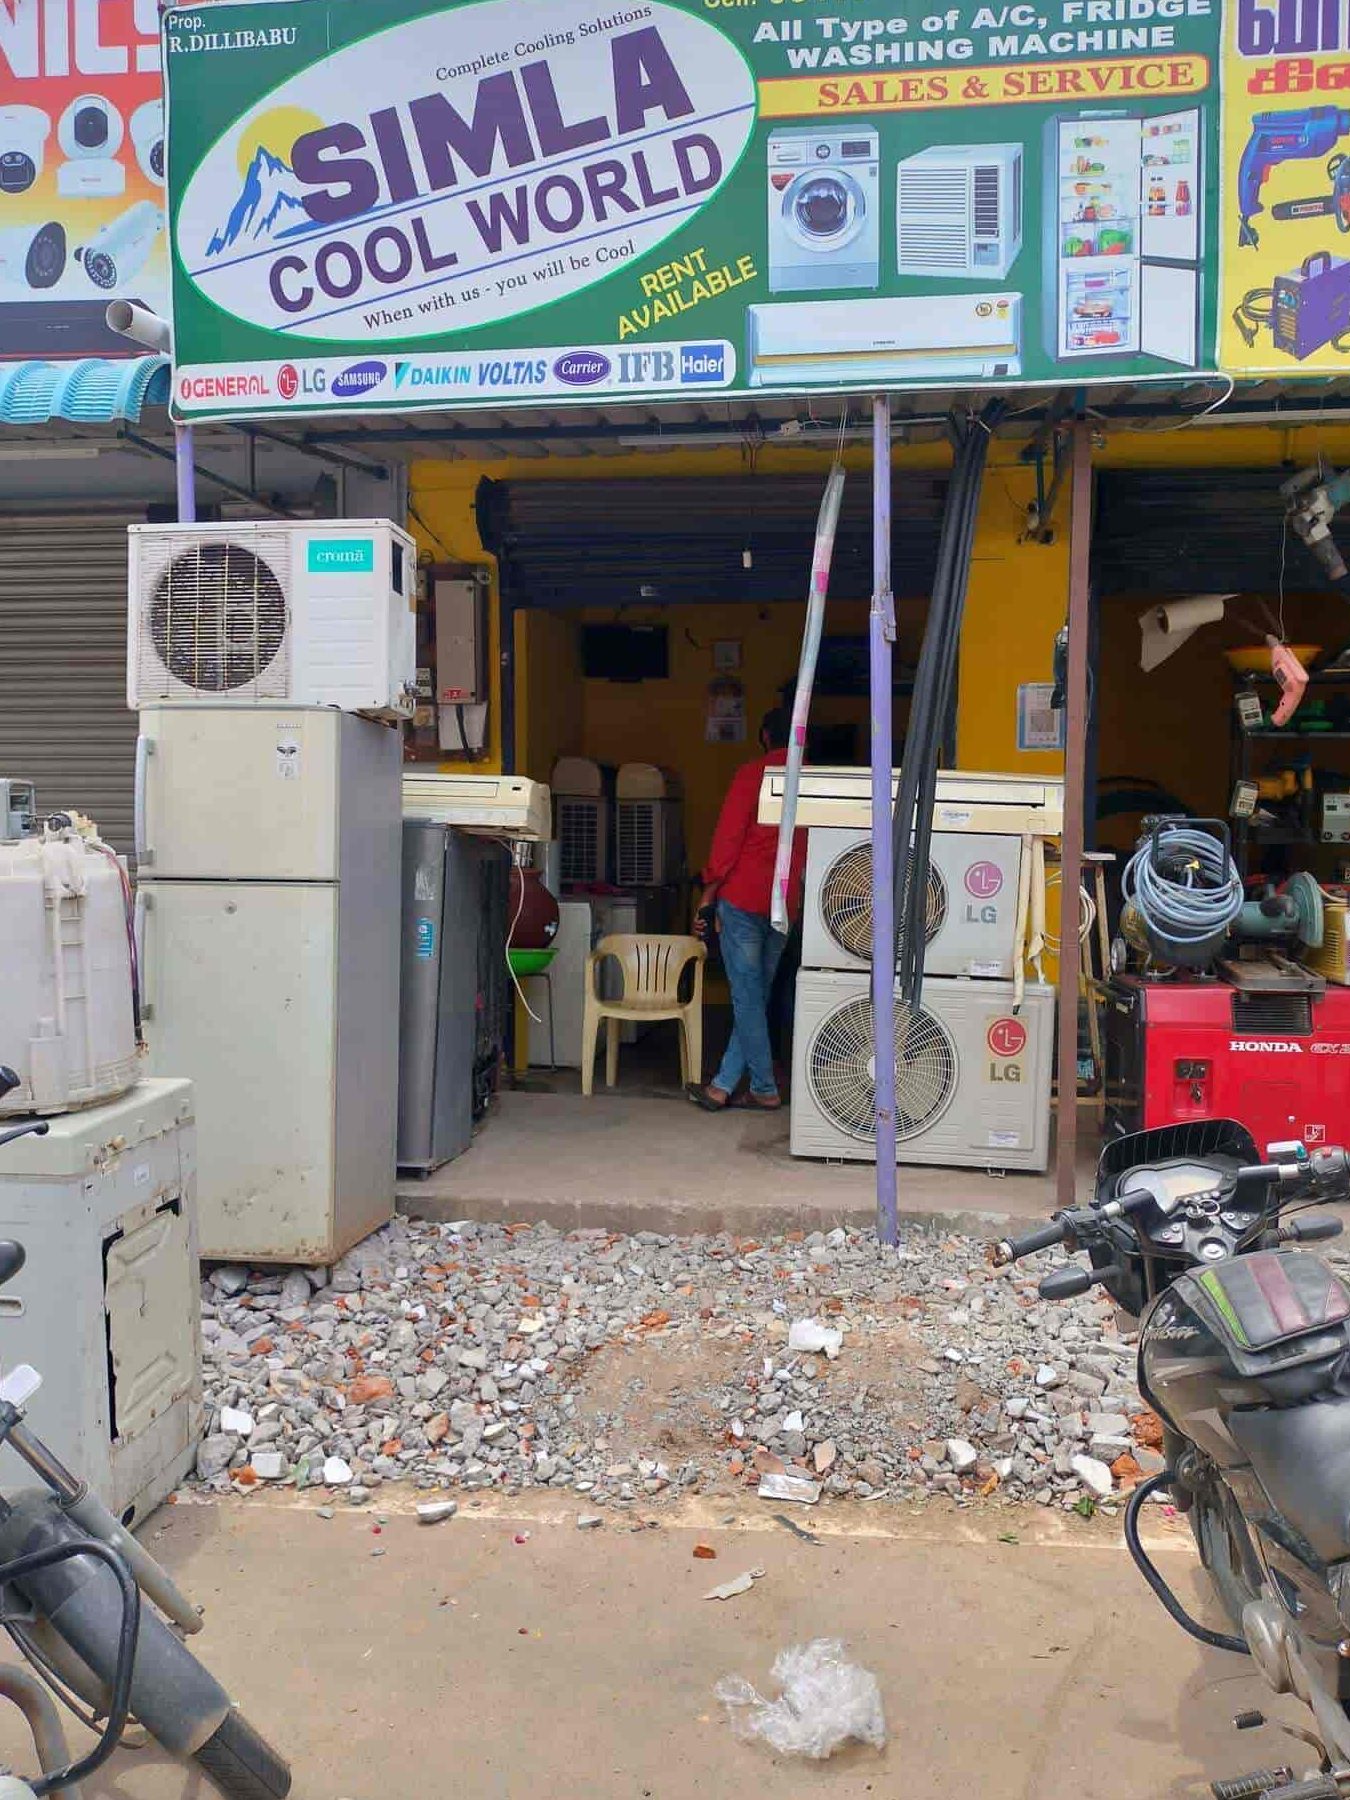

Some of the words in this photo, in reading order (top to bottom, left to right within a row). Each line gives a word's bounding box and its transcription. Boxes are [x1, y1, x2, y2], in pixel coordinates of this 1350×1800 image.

[169, 15, 206, 30] Prop.
[169, 27, 297, 53] R.DILLIBABU
[436, 51, 510, 81] Complete
[514, 31, 575, 57] Cooling
[580, 6, 653, 37] Solutions
[753, 20, 801, 43] All
[816, 16, 908, 43] Type
[921, 9, 960, 33] of
[971, 4, 1048, 30] A/C,
[1063, 0, 1212, 24] FRIDGE
[786, 38, 973, 69] WASHING
[988, 25, 1175, 57] MACHINE
[818, 76, 949, 108] SALES
[961, 75, 989, 99] &
[1002, 62, 1194, 97] SERVICE
[291, 26, 695, 225] SIMLA
[269, 216, 459, 313] COOL
[465, 133, 723, 253] WORLD
[363, 306, 414, 330] When
[417, 293, 457, 316] with
[461, 286, 480, 303] us
[495, 273, 528, 296] you
[532, 259, 565, 281] will
[570, 254, 591, 272] be
[595, 240, 636, 262] Cool
[639, 247, 709, 297] RENT
[618, 255, 758, 340] AVAILABLE
[302, 368, 326, 393] LG
[337, 370, 382, 388] SAMSUNG
[411, 365, 470, 386] DAIKIN
[478, 359, 548, 386] VOLTAS
[560, 359, 604, 377] Carrier
[618, 351, 675, 384] IFB
[681, 354, 724, 375] Haier
[966, 904, 998, 924] LG
[1229, 1040, 1304, 1053] HONDA
[990, 1062, 1021, 1082] LG
